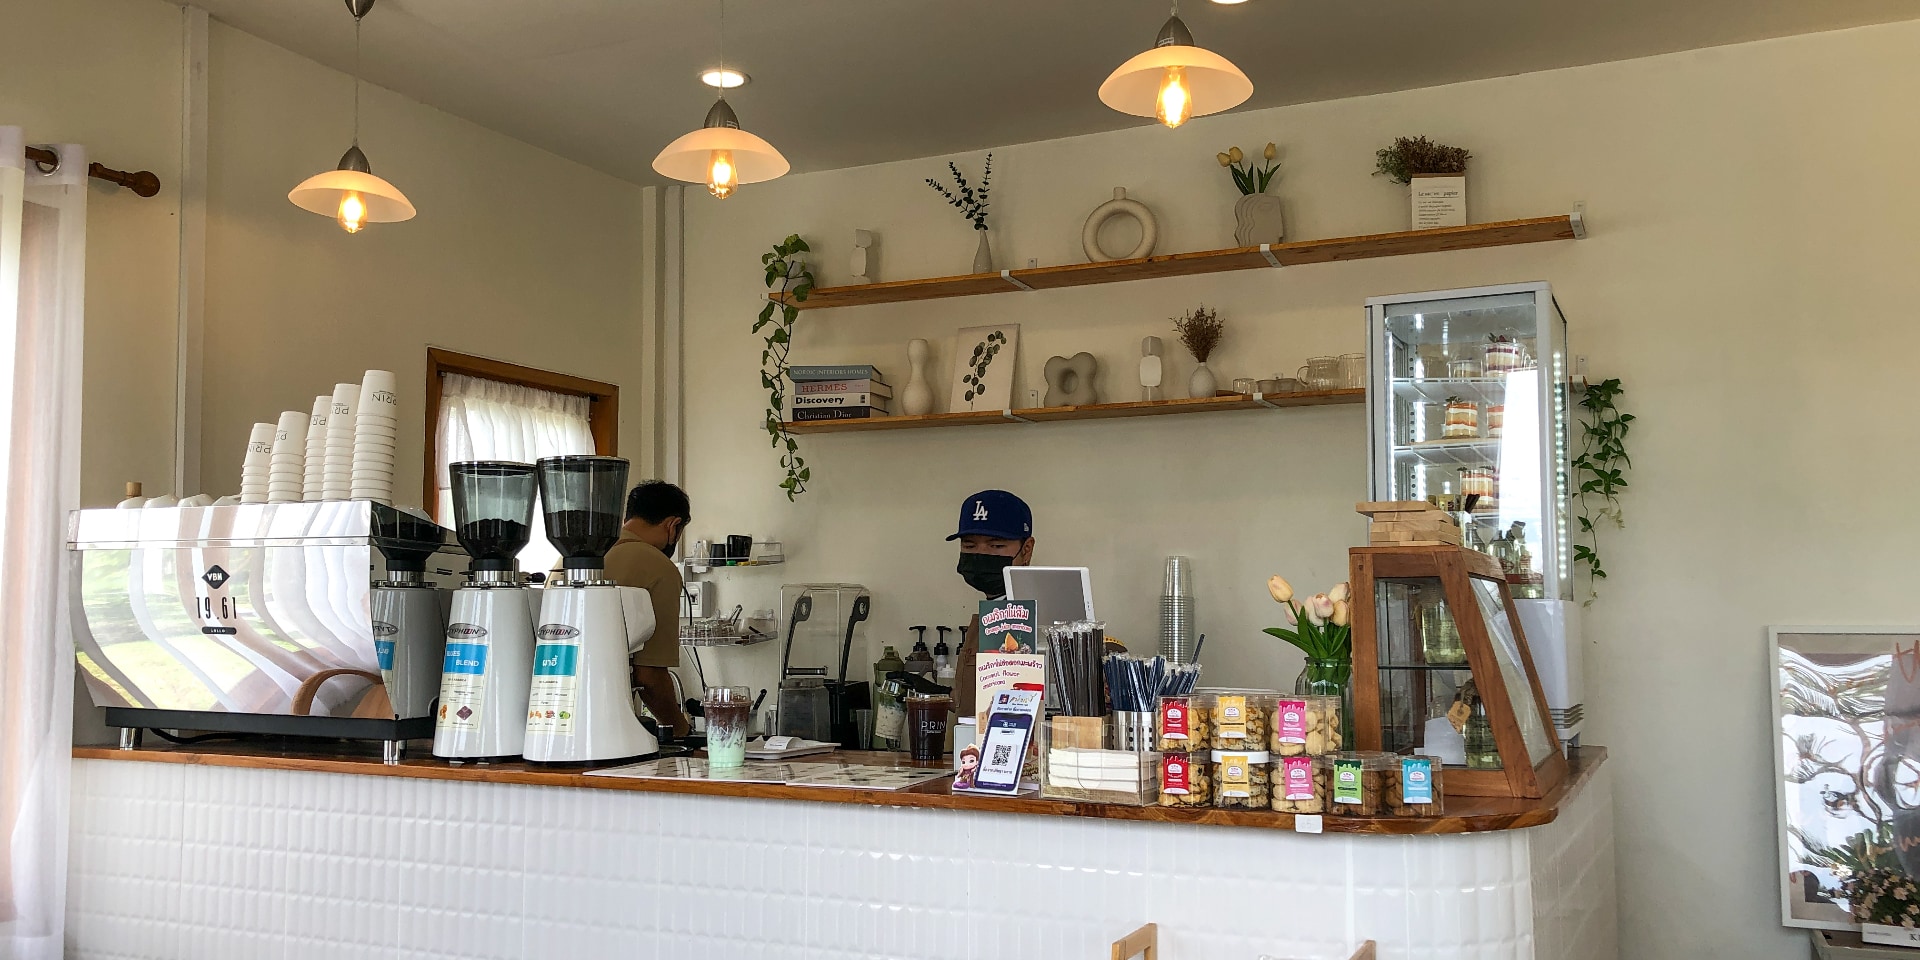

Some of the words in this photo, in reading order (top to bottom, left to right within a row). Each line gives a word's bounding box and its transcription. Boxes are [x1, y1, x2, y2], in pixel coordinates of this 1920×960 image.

[801, 384, 848, 393] HERMES
[795, 396, 844, 405] Discovery
[797, 411, 831, 420] Christian
[833, 410, 852, 418] Dior
[972, 500, 989, 521] LA
[206, 572, 223, 581] VBM
[455, 659, 480, 667] BLEND
[920, 720, 946, 730] PRIN
